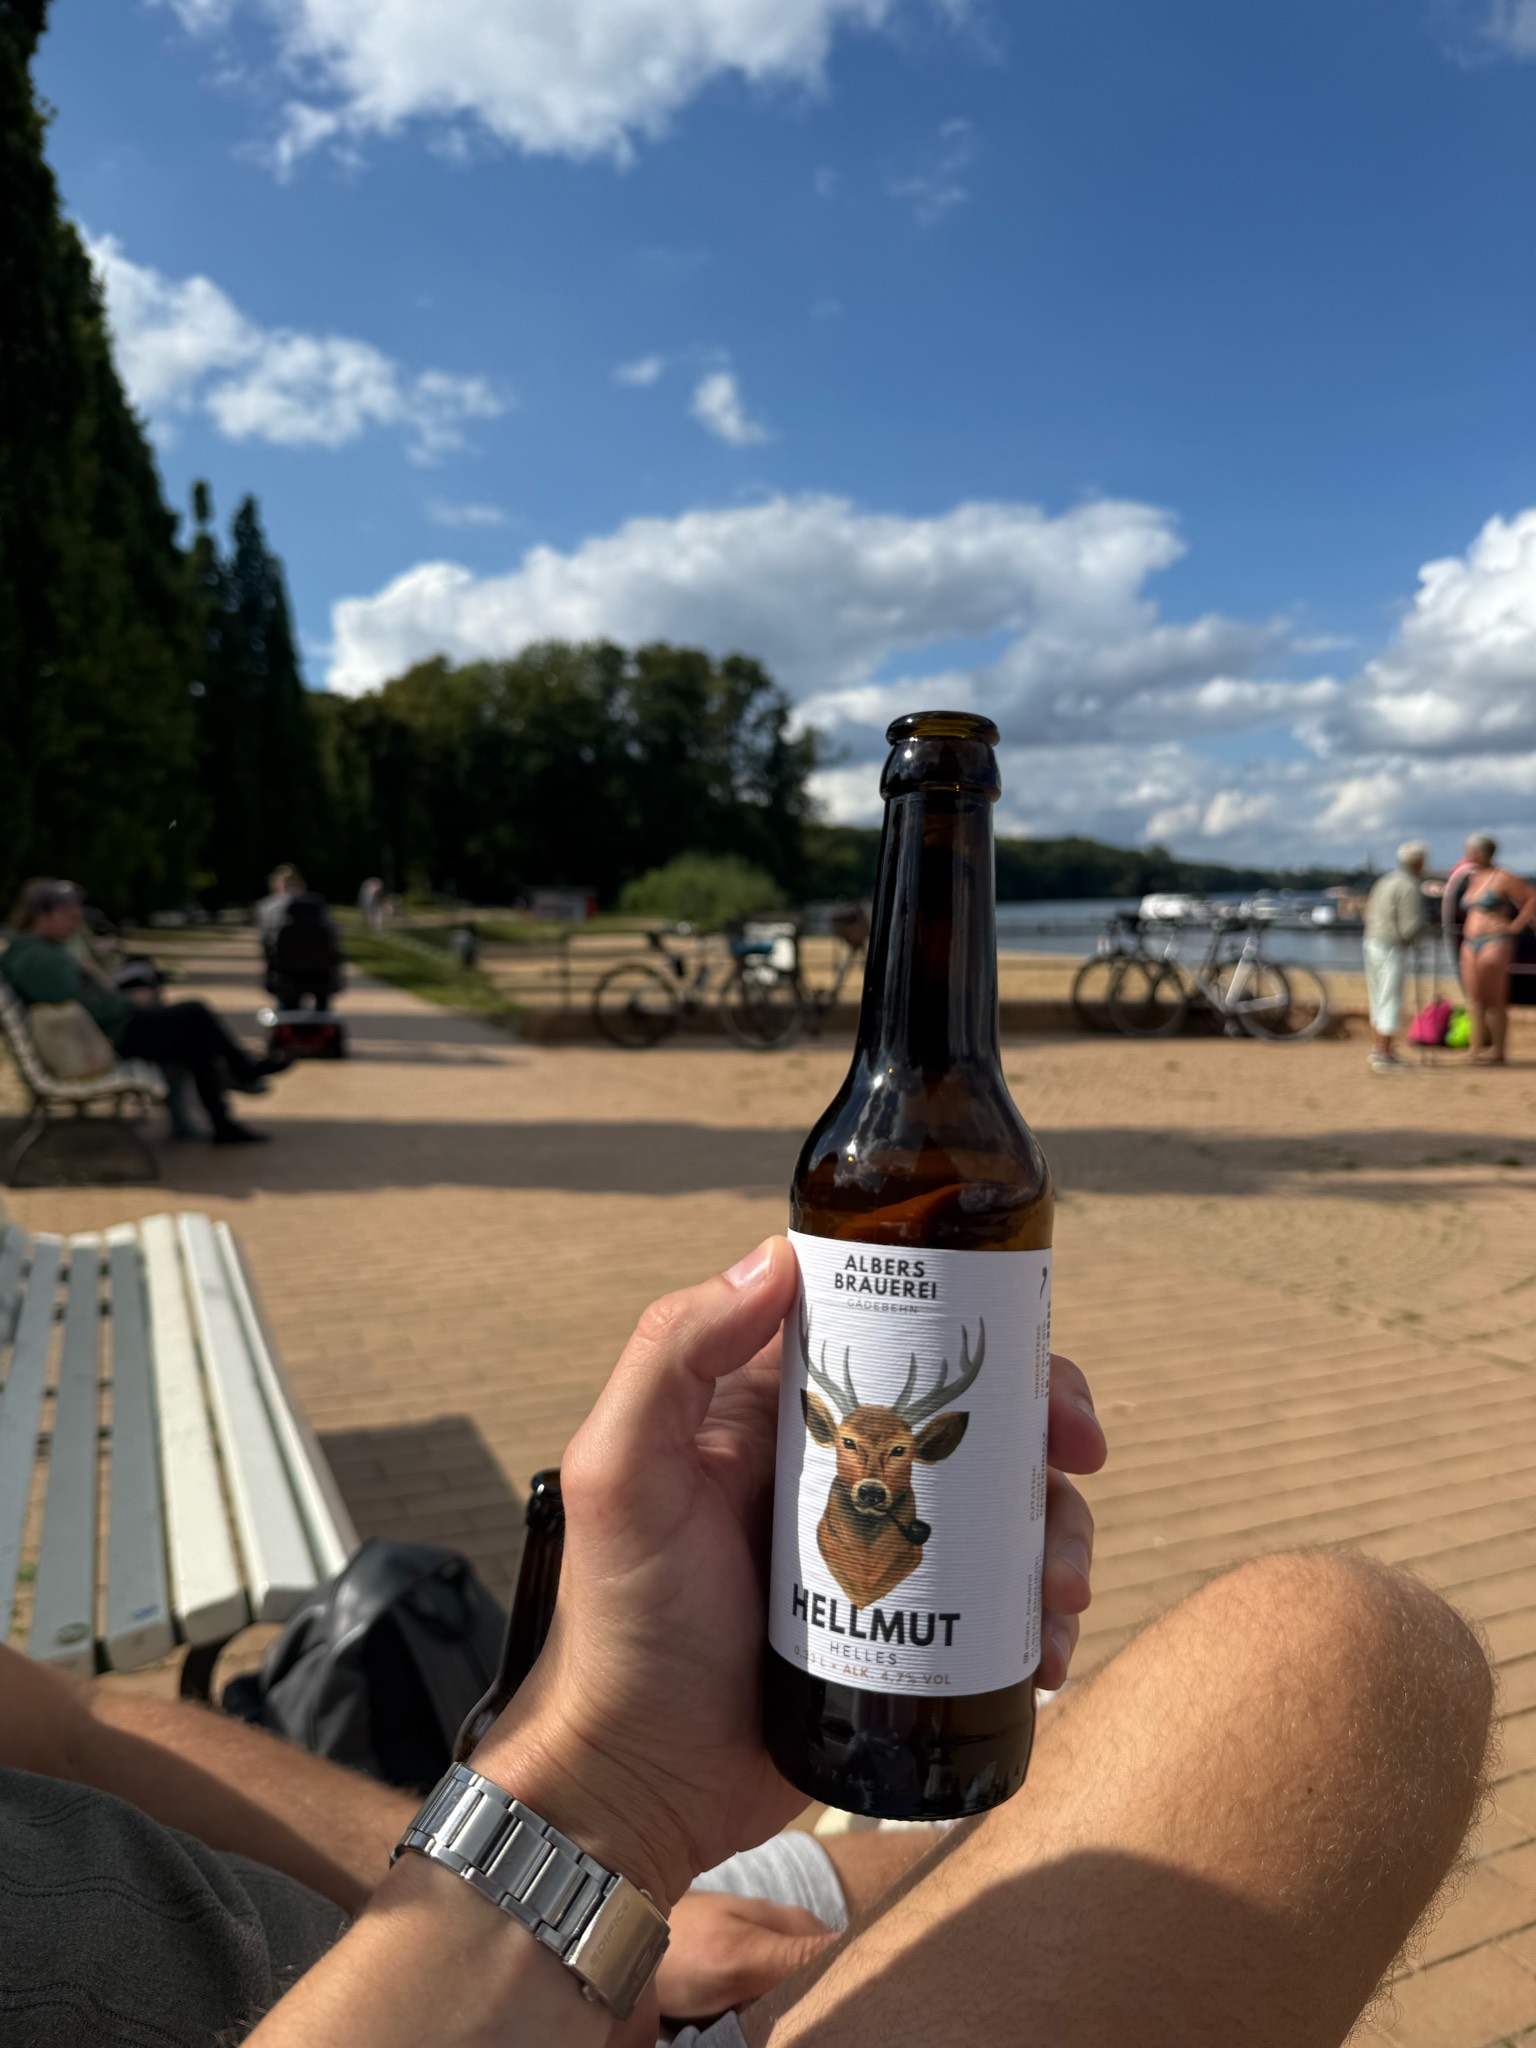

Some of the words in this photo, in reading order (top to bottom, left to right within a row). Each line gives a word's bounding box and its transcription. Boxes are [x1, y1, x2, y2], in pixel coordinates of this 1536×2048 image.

[844, 1254, 926, 1278] ALBERS
[834, 1272, 937, 1299] BRAUEREI
[792, 1583, 961, 1647] HELLMUT
[830, 1640, 898, 1665] HELLES
[923, 1674, 952, 1685] VOL
